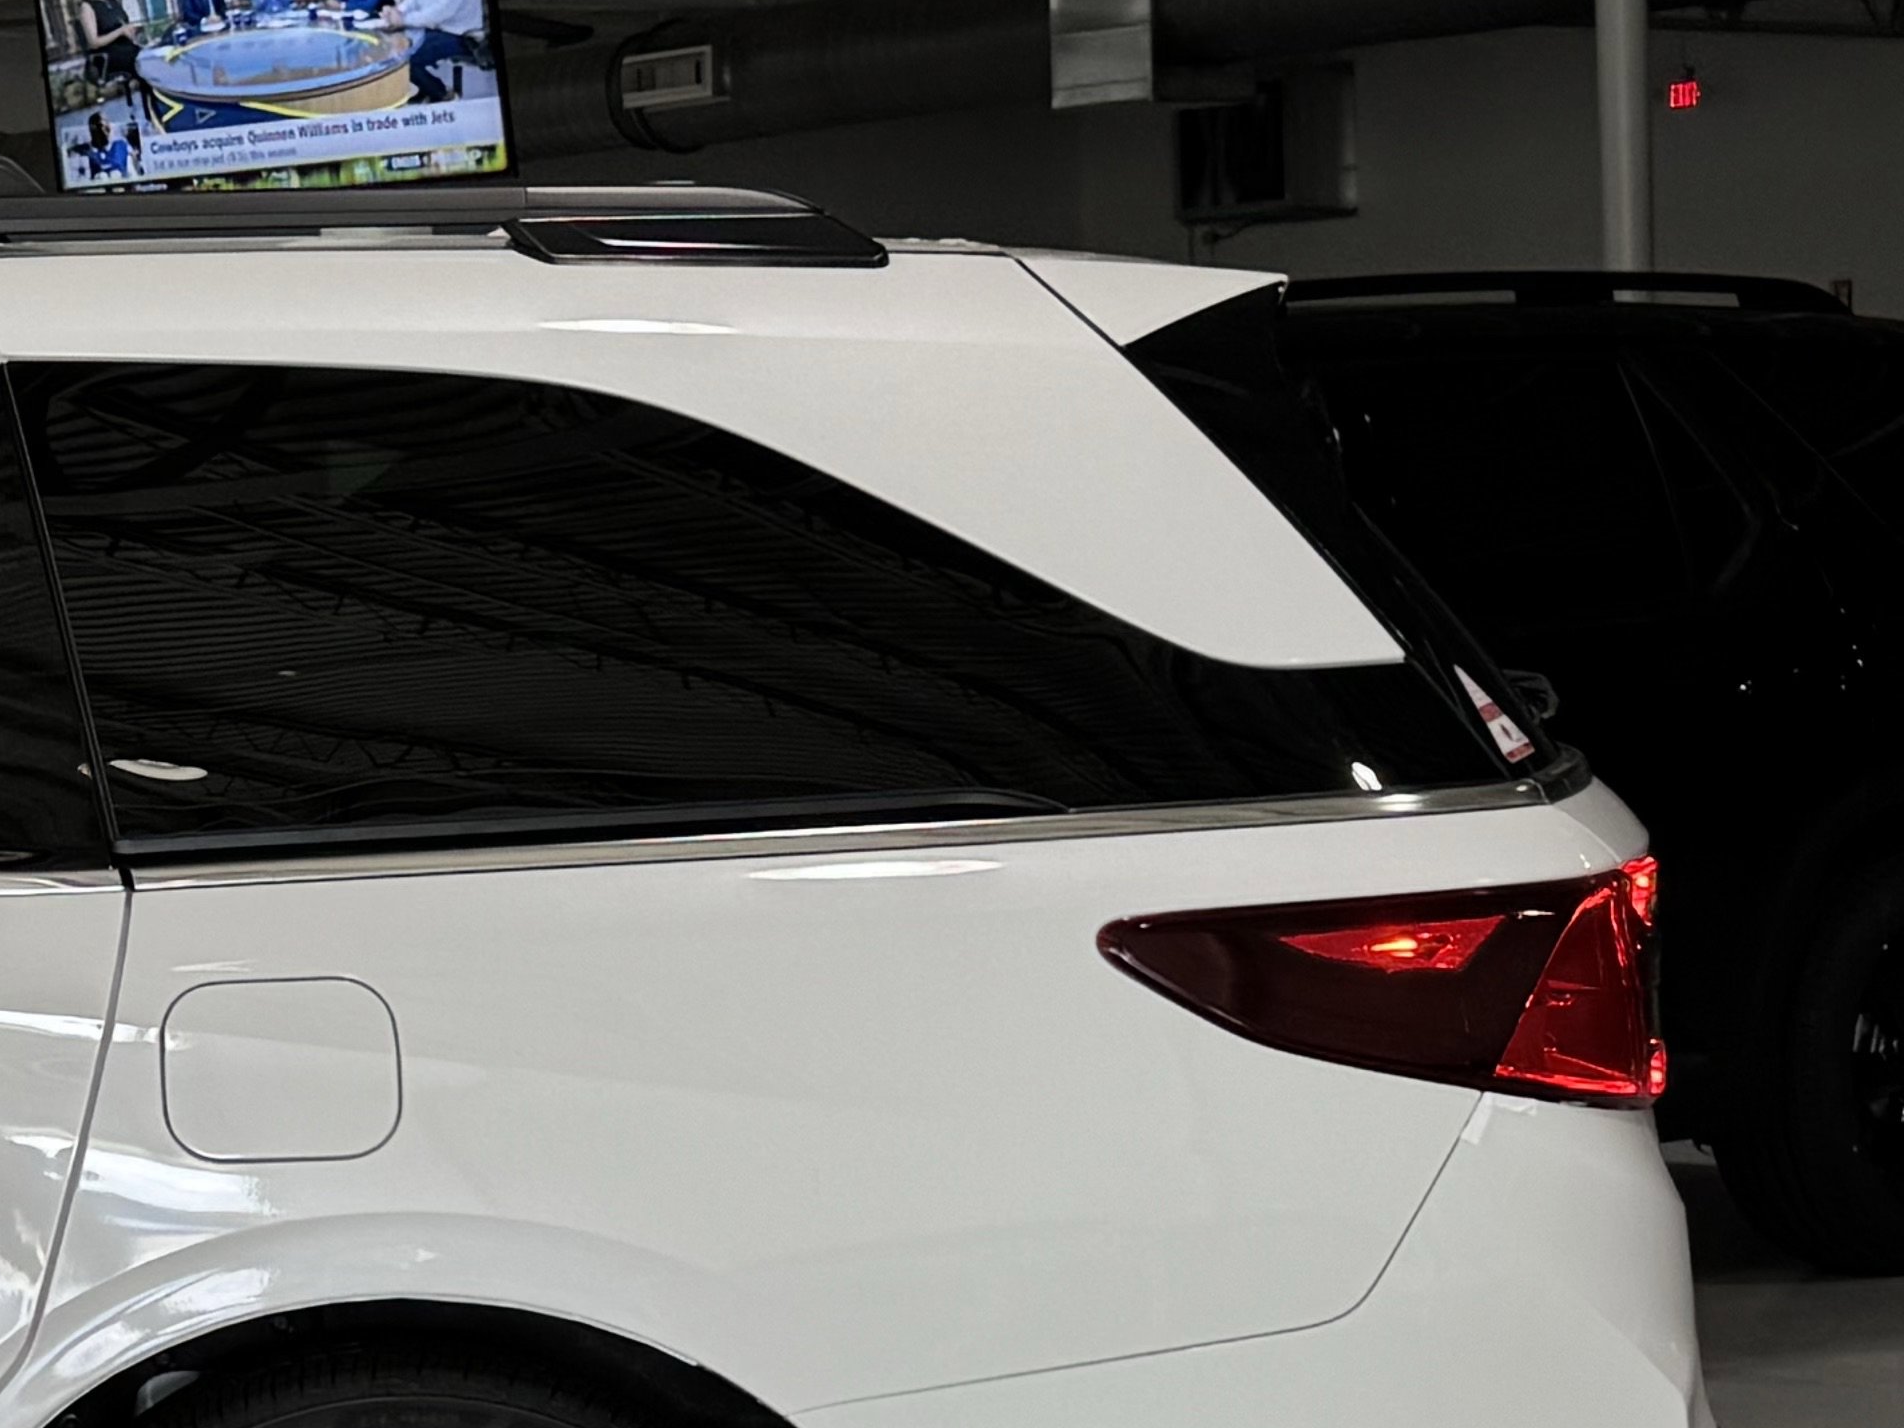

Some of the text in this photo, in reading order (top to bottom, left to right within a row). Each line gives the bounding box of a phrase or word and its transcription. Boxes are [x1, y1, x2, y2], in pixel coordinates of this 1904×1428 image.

[150, 139, 199, 154] Cowboys
[202, 134, 245, 151] acquire
[297, 123, 349, 138] Williams
[351, 119, 363, 132] in
[366, 116, 398, 131] trade
[401, 112, 428, 127] with
[431, 110, 455, 124] Jets
